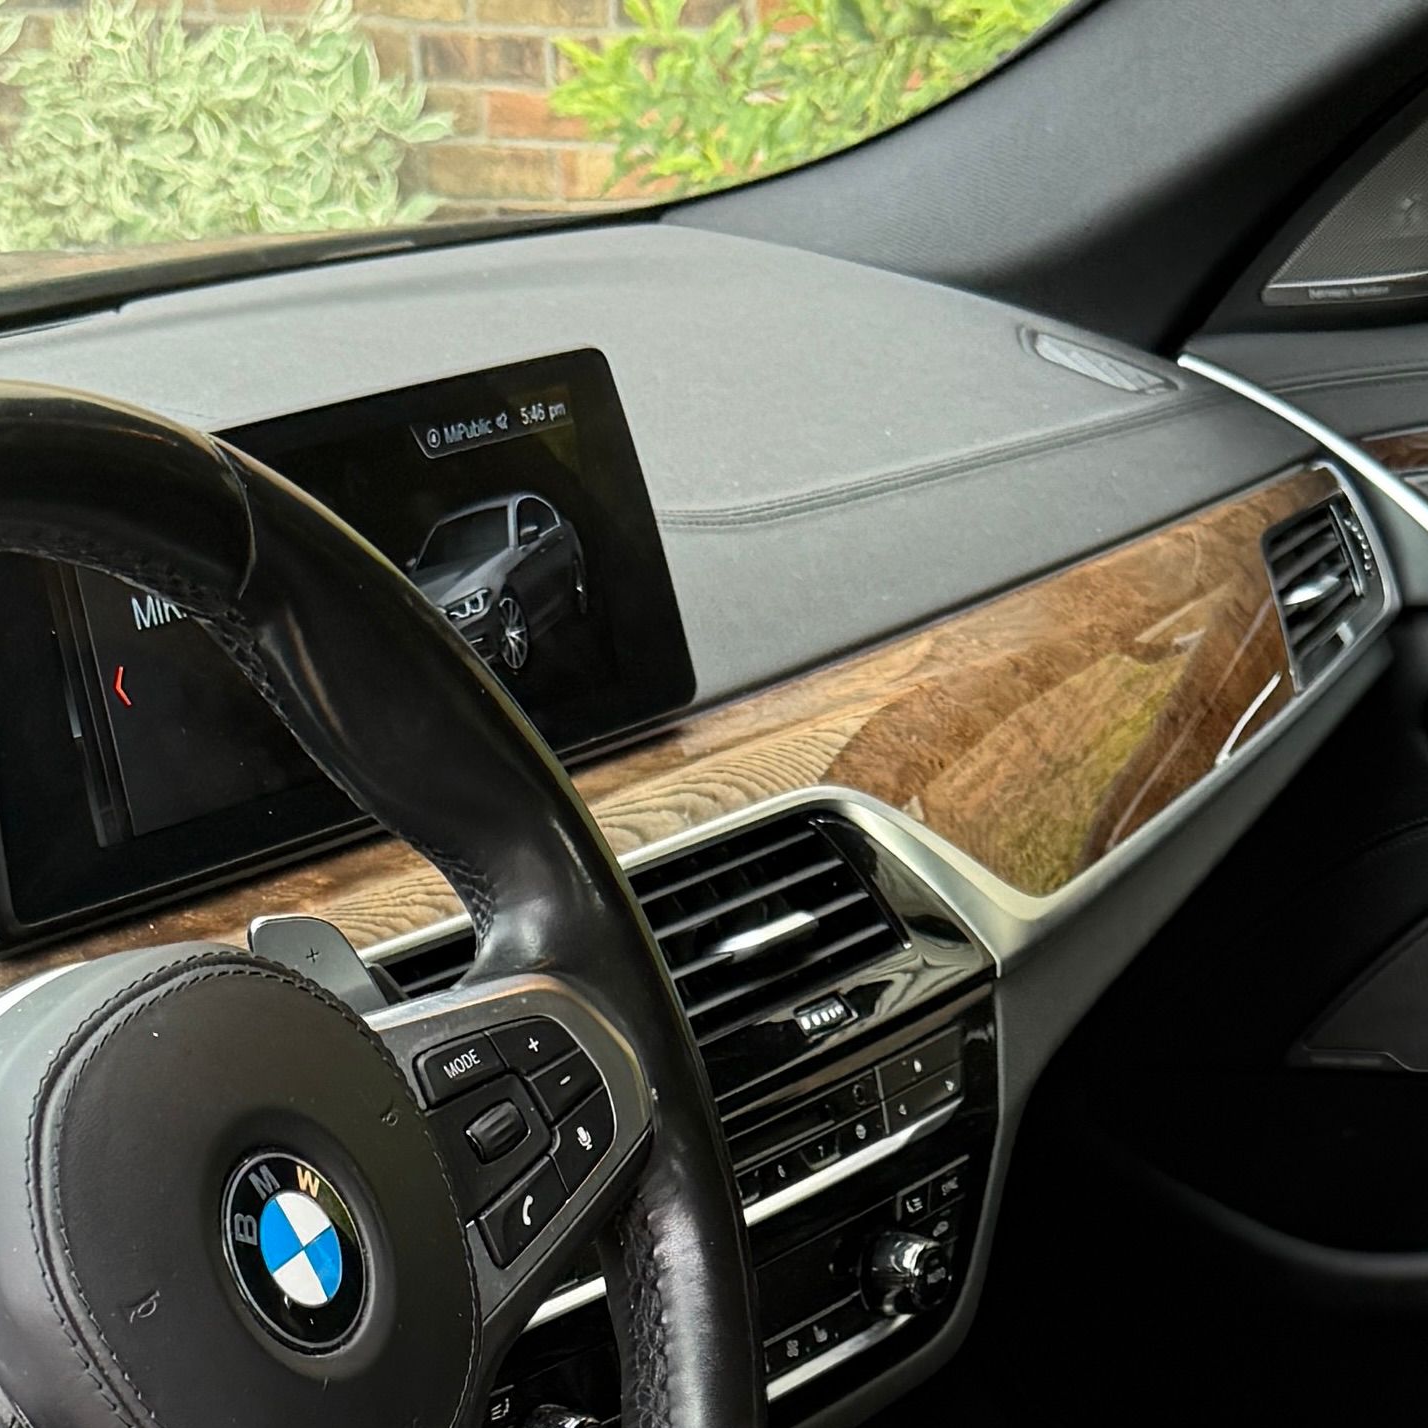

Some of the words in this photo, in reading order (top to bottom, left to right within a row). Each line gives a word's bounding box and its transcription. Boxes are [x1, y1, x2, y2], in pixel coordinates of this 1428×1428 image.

[520, 403, 546, 425] 5:46
[548, 402, 566, 421] pm
[443, 1048, 481, 1079] MODE
[234, 1164, 320, 1246] BMW
